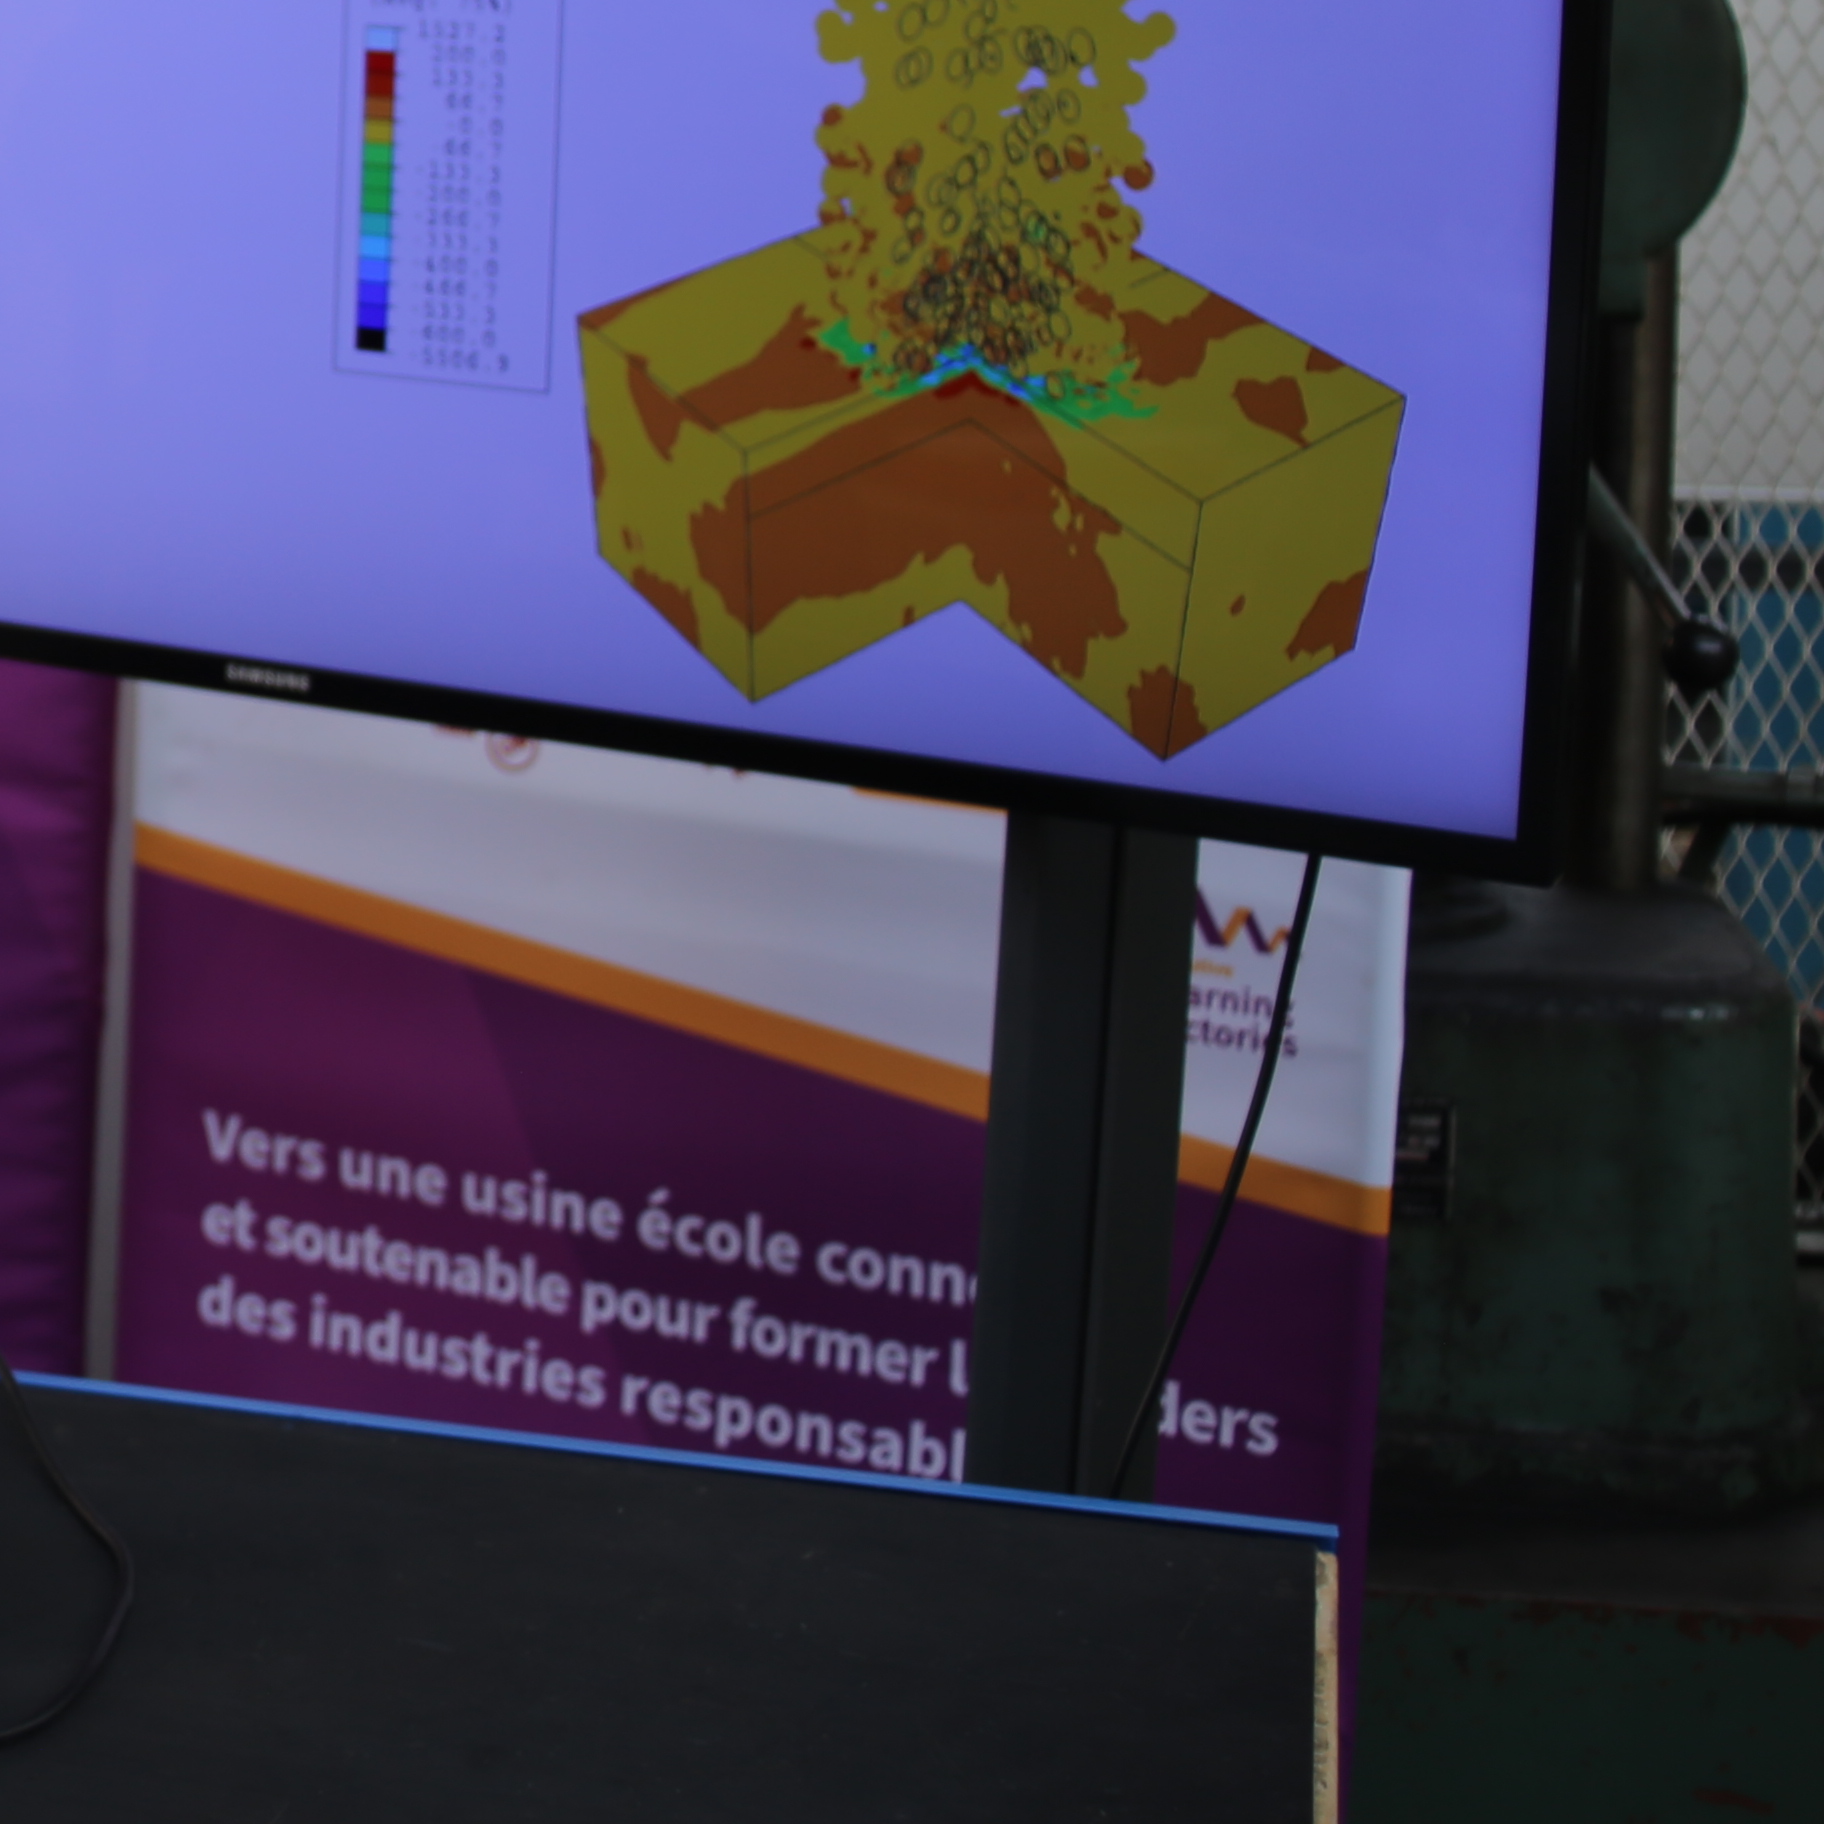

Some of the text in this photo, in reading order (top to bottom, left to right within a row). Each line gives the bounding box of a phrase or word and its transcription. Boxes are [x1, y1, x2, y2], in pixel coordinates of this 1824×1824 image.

[200, 1198, 257, 1251] et
[264, 1212, 572, 1317] soutenable
[581, 1277, 721, 1335] pour
[729, 1296, 940, 1389] former
[202, 1108, 978, 1307] Vers une usine école conn
[196, 1273, 298, 1342] des
[309, 1293, 608, 1410] industries
